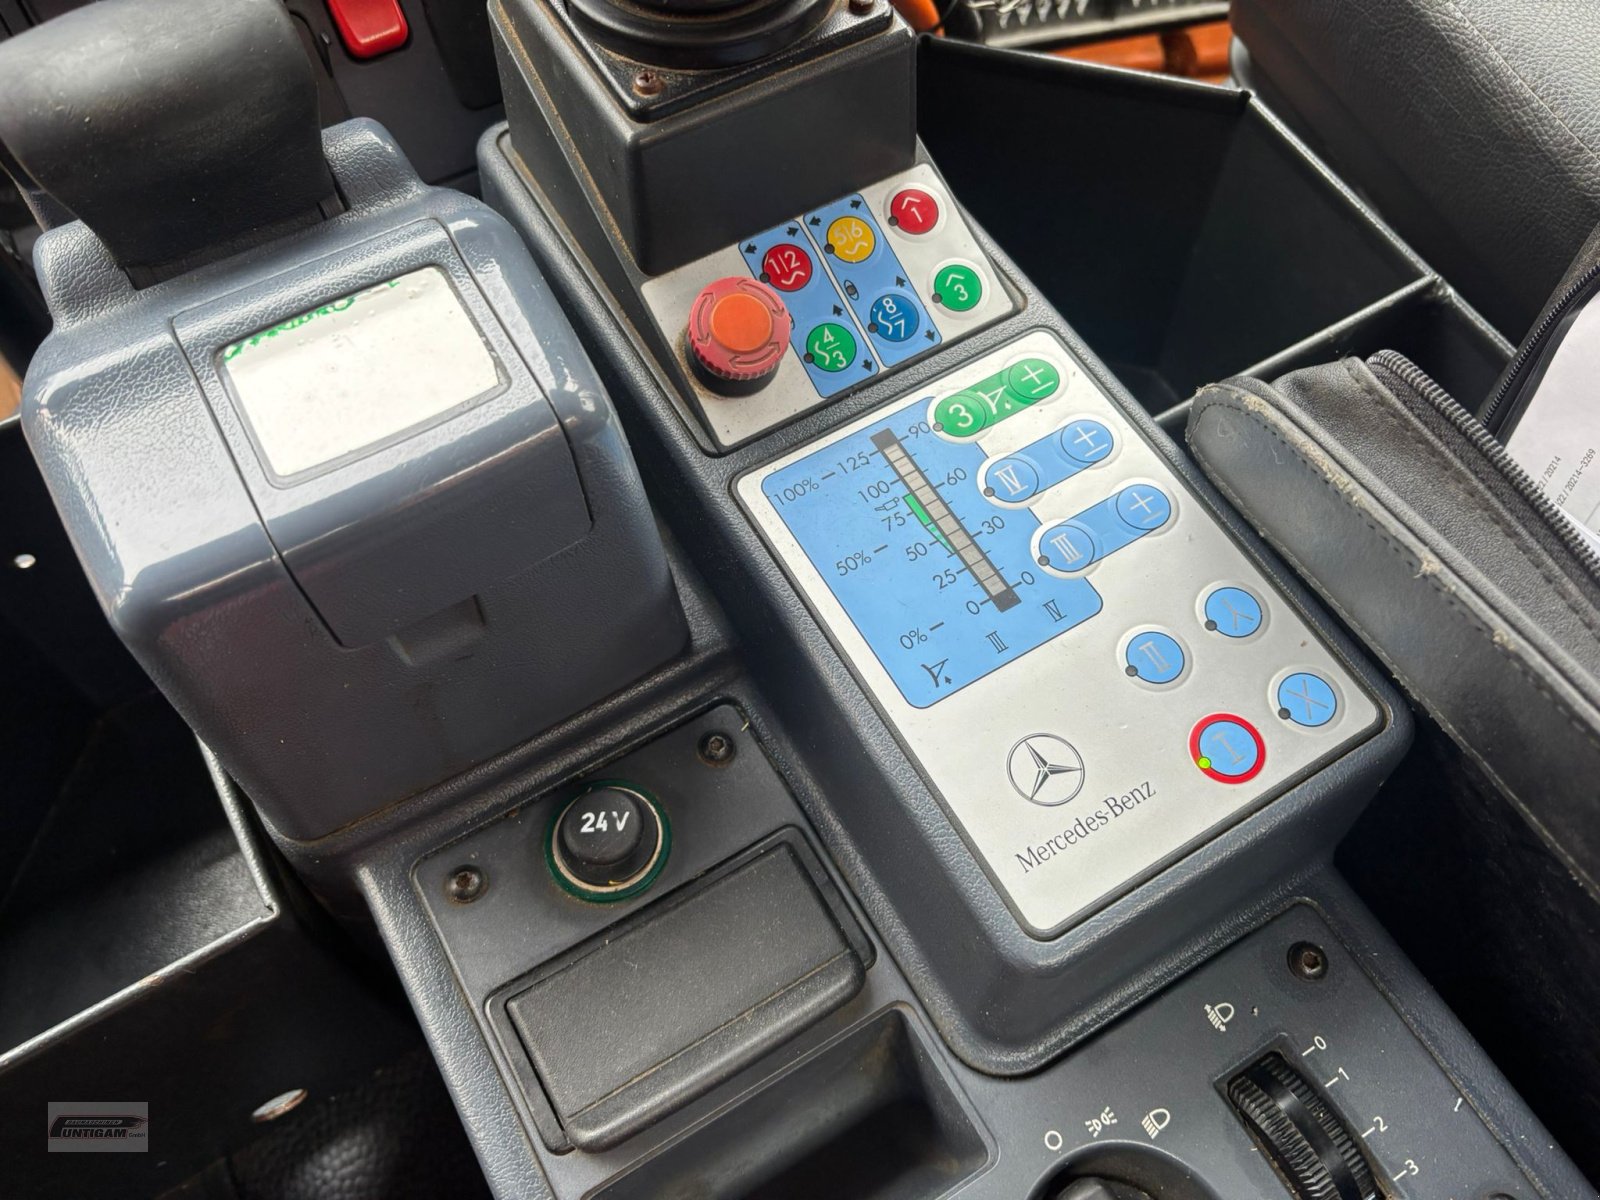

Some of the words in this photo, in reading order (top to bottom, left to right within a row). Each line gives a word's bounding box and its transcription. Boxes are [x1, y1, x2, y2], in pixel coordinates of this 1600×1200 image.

[911, 205, 923, 223] 1
[954, 284, 969, 301] 3
[948, 403, 974, 428] 3
[908, 420, 930, 439] 90
[837, 452, 870, 475] 125
[1544, 455, 1561, 478] 20214
[946, 466, 968, 487] 60
[774, 477, 820, 508] 100%
[857, 480, 891, 505] 100
[881, 513, 906, 532] 75
[982, 515, 1006, 535] 30
[905, 542, 929, 562] 50
[836, 551, 873, 577] 50%
[932, 569, 958, 590] 25
[1020, 570, 1035, 586] 0
[965, 600, 981, 616] 0
[1041, 599, 1068, 623] IV
[899, 627, 929, 651] 0%
[985, 631, 1009, 655] III
[1014, 780, 1157, 874] Mercedes-Benz
[1314, 1035, 1327, 1050] 0
[1338, 1066, 1350, 1081] 1
[1373, 1116, 1389, 1132] 2
[1404, 1159, 1419, 1176] 3
